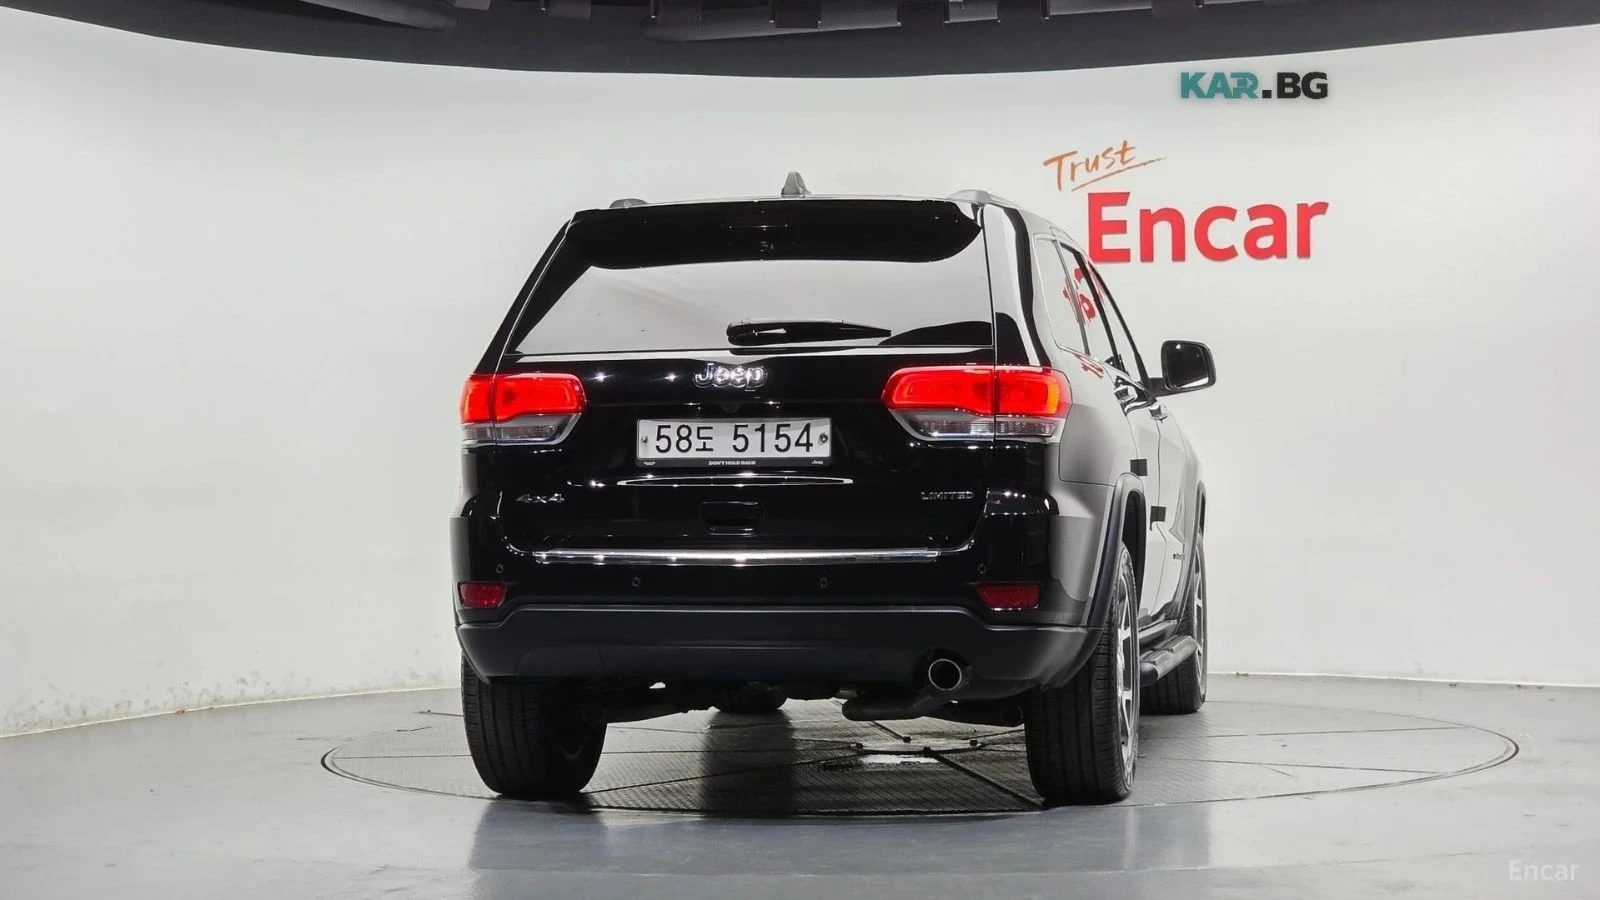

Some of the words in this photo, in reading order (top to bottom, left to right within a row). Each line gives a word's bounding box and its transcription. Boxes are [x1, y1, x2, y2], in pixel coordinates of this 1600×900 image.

[1042, 140, 1137, 192] Trust
[1087, 191, 1329, 263] Encar
[693, 362, 766, 390] Jeep
[655, 424, 714, 453] 58도
[732, 423, 813, 453] 5154
[920, 490, 975, 500] LIMITED
